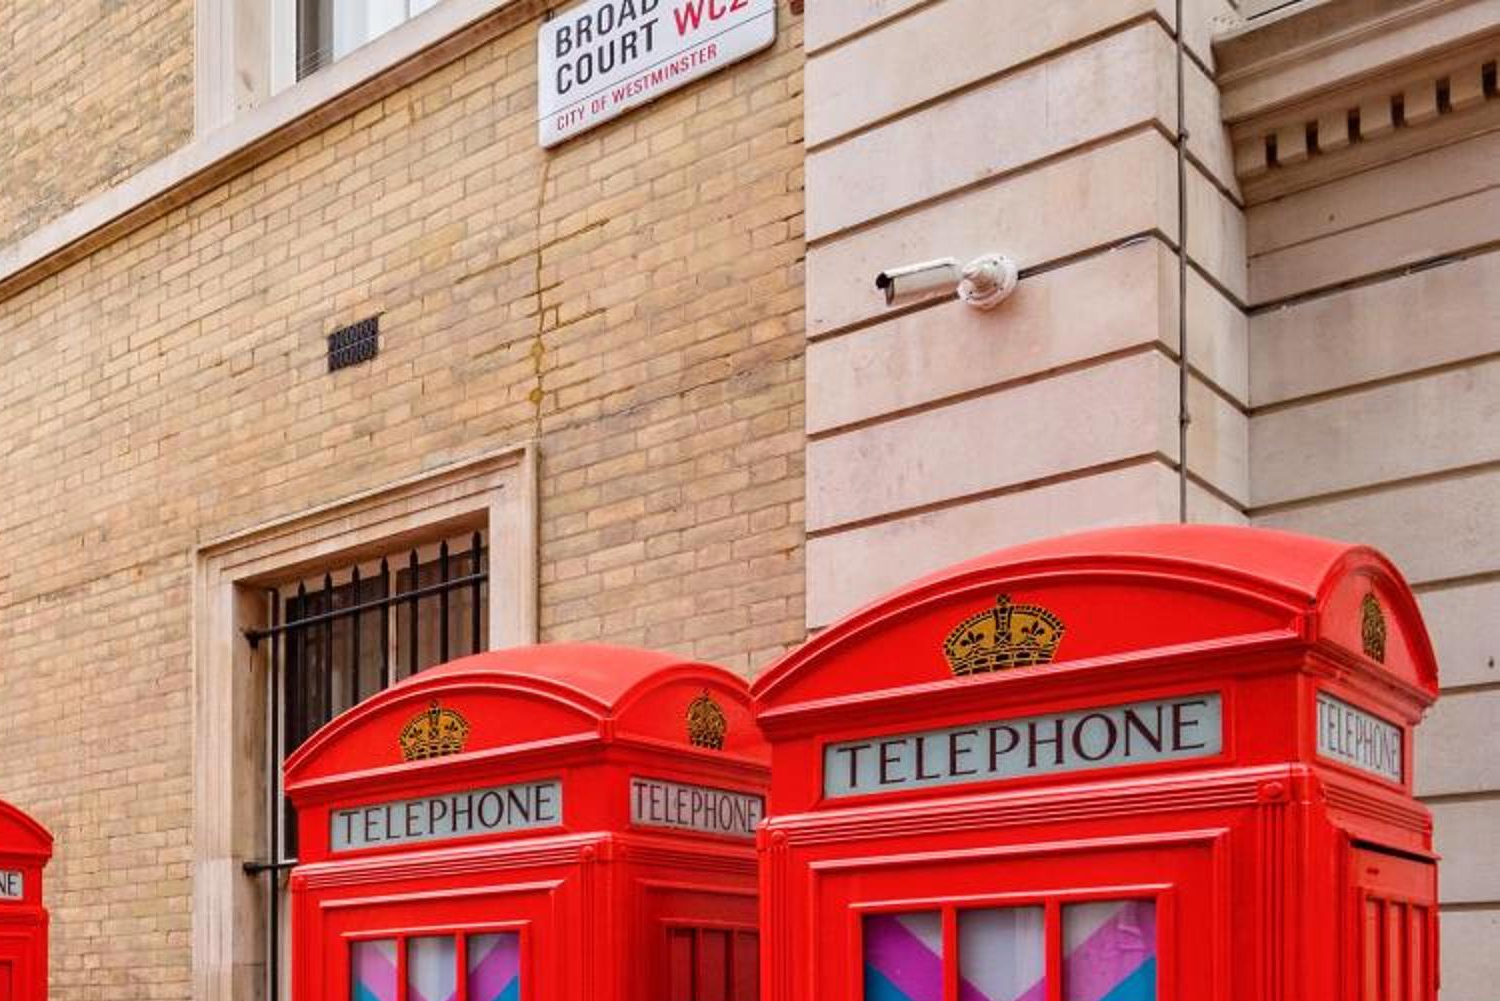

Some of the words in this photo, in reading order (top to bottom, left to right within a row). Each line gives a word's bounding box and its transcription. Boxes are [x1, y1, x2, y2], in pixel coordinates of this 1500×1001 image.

[557, 18, 659, 95] COURT
[557, 106, 586, 131] CITY
[591, 98, 609, 115] OF
[611, 43, 719, 105] WESTMINSTER
[837, 700, 1208, 789] TELEPHONE
[1316, 699, 1400, 776] TELEPHONE
[339, 783, 556, 845] TELEPHONE
[633, 781, 758, 833] TELEPHONE
